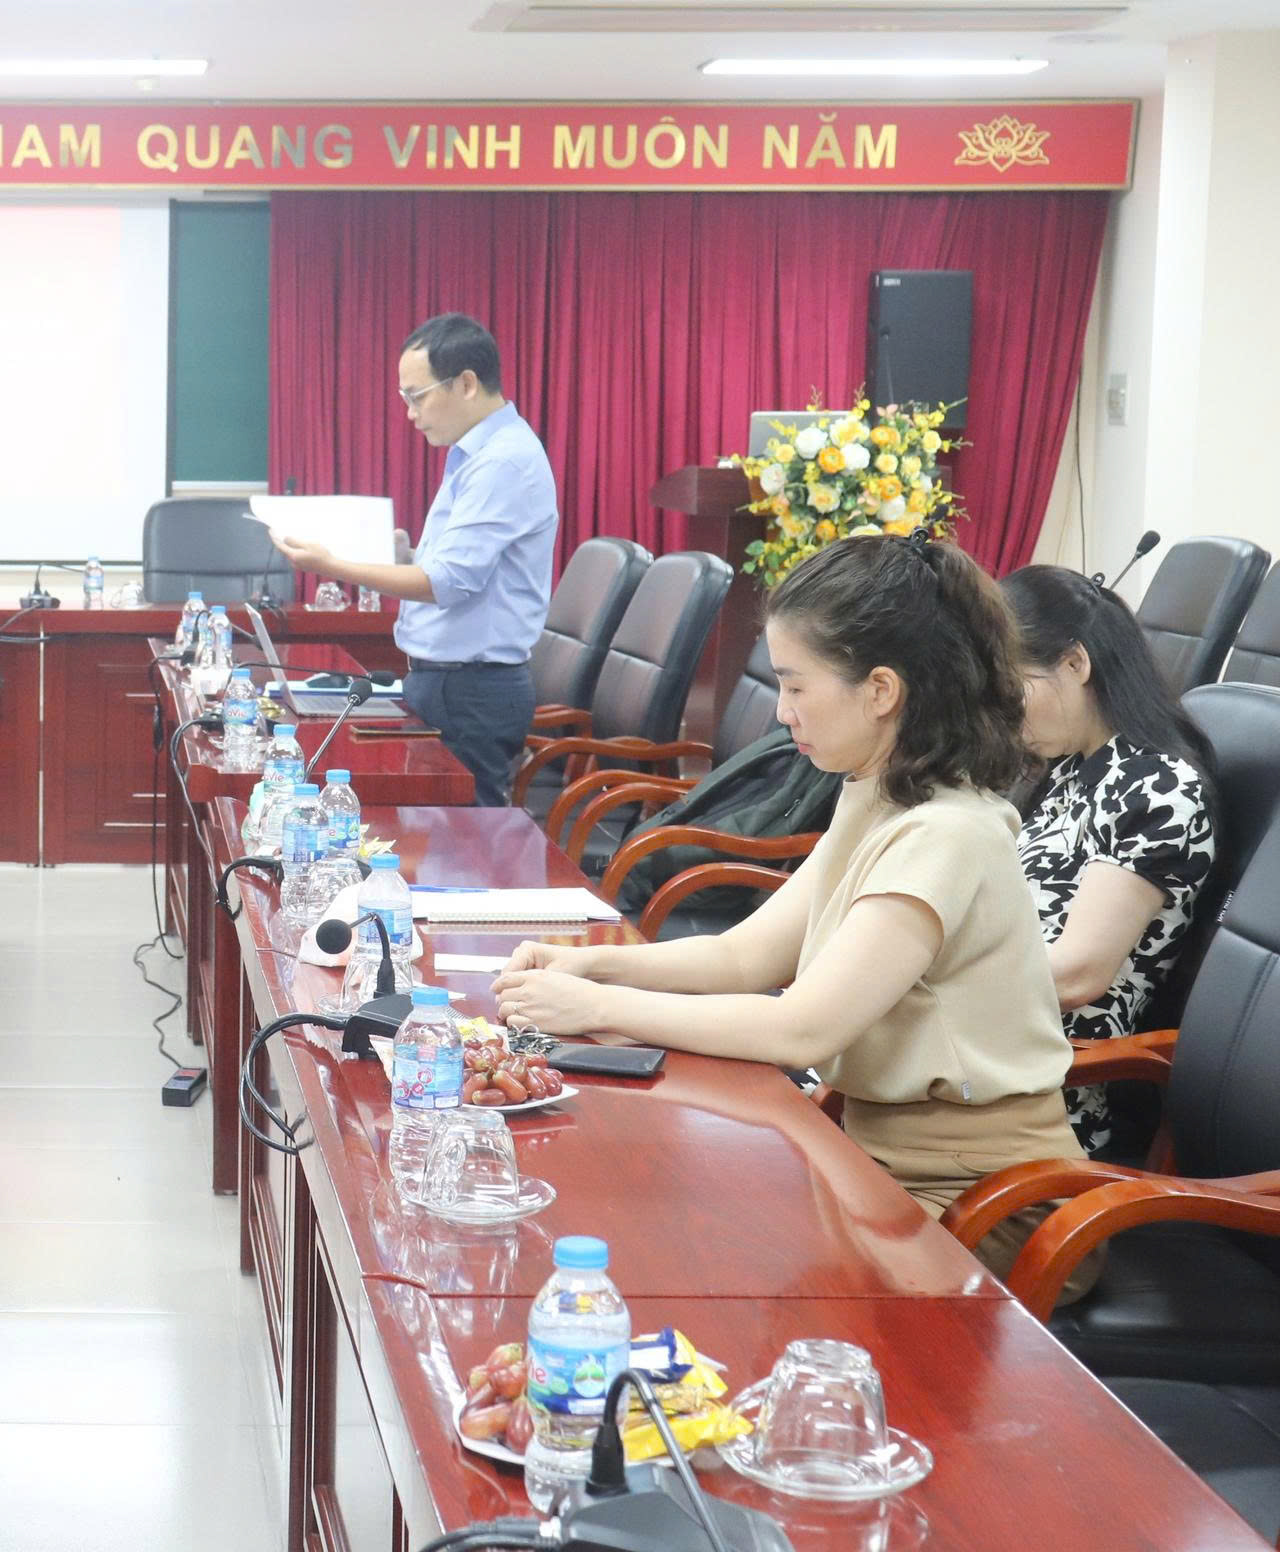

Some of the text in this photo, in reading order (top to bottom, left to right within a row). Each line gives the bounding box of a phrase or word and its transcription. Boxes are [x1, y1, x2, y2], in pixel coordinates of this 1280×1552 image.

[136, 124, 353, 173] QUANG
[382, 124, 521, 169] VINH
[552, 116, 729, 169] MUÔN
[762, 112, 898, 169] NĂM
